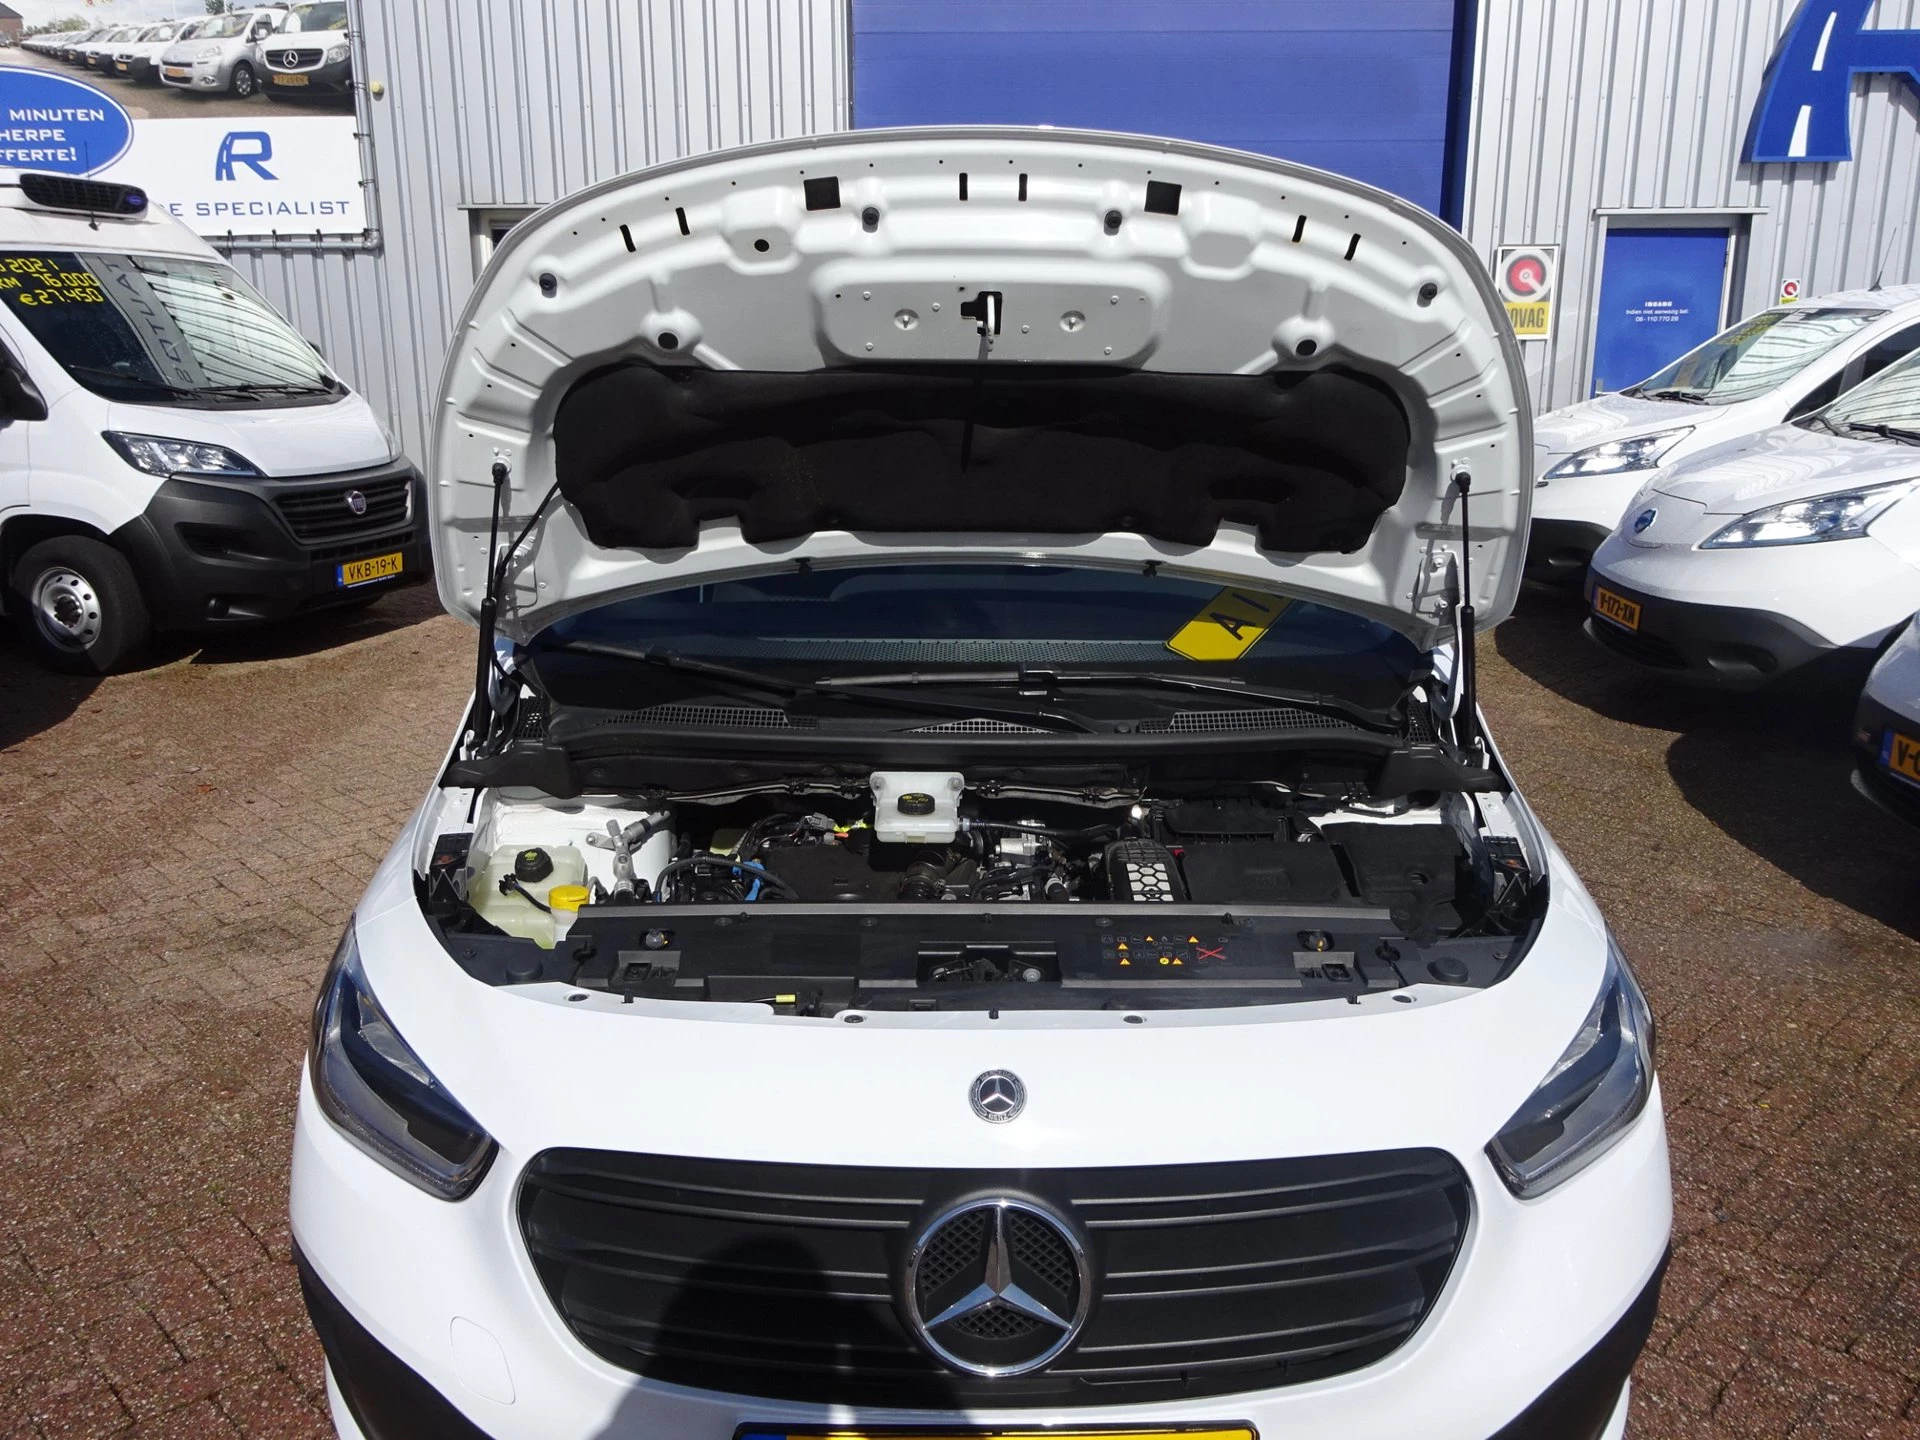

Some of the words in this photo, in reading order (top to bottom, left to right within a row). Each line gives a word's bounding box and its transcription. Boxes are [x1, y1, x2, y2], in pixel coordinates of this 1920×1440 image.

[9, 109, 105, 121] MINUTEN
[196, 201, 350, 217] SPECIALIST
[5, 258, 59, 273] 2021
[32, 273, 101, 287] 76.000
[20, 288, 104, 305] €27.450
[1506, 307, 1545, 328] OVAG
[348, 556, 398, 580] VKB-19-K
